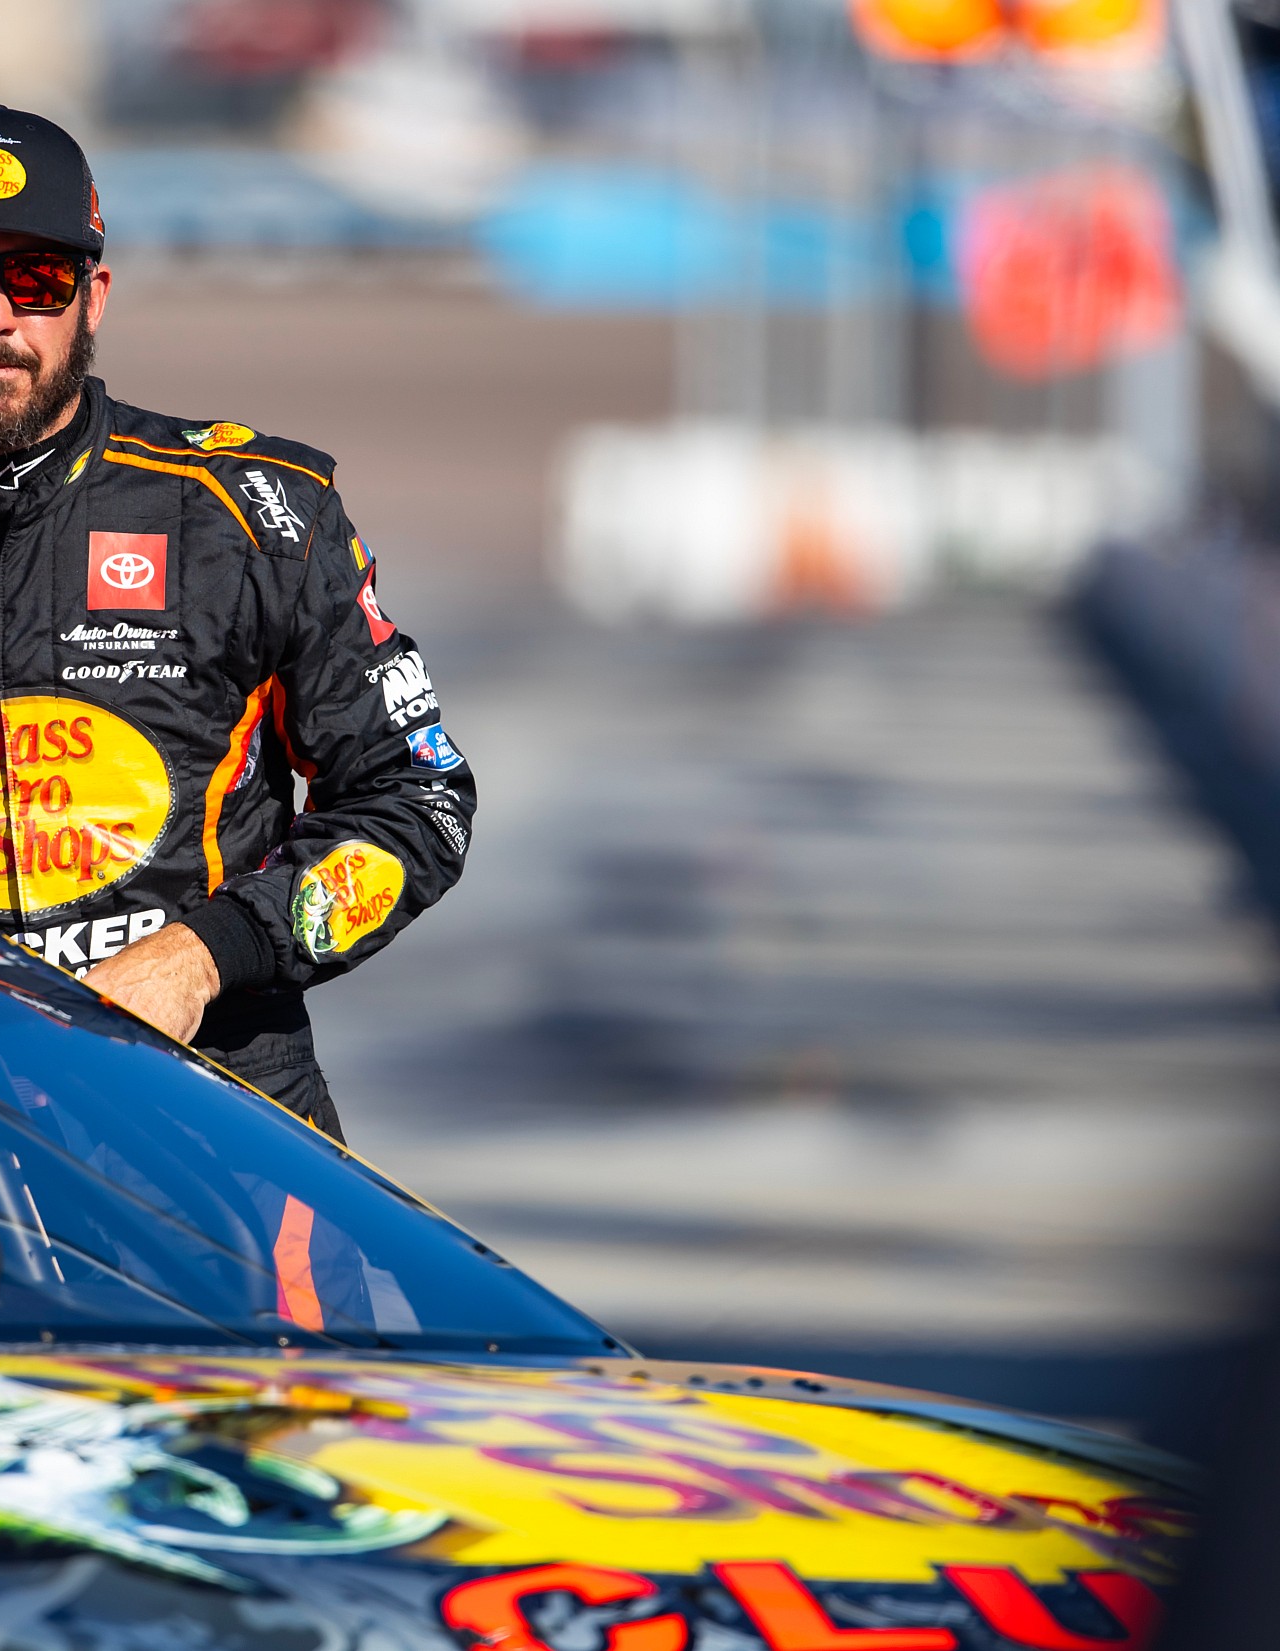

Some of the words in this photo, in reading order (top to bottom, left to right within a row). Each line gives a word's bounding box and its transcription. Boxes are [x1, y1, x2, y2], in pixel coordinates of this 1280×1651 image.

[245, 469, 300, 543] IMPACT
[60, 622, 179, 642] Auto-Owners
[83, 640, 156, 650] INSURANCE
[317, 848, 366, 892] Bass
[345, 887, 395, 936] Shops
